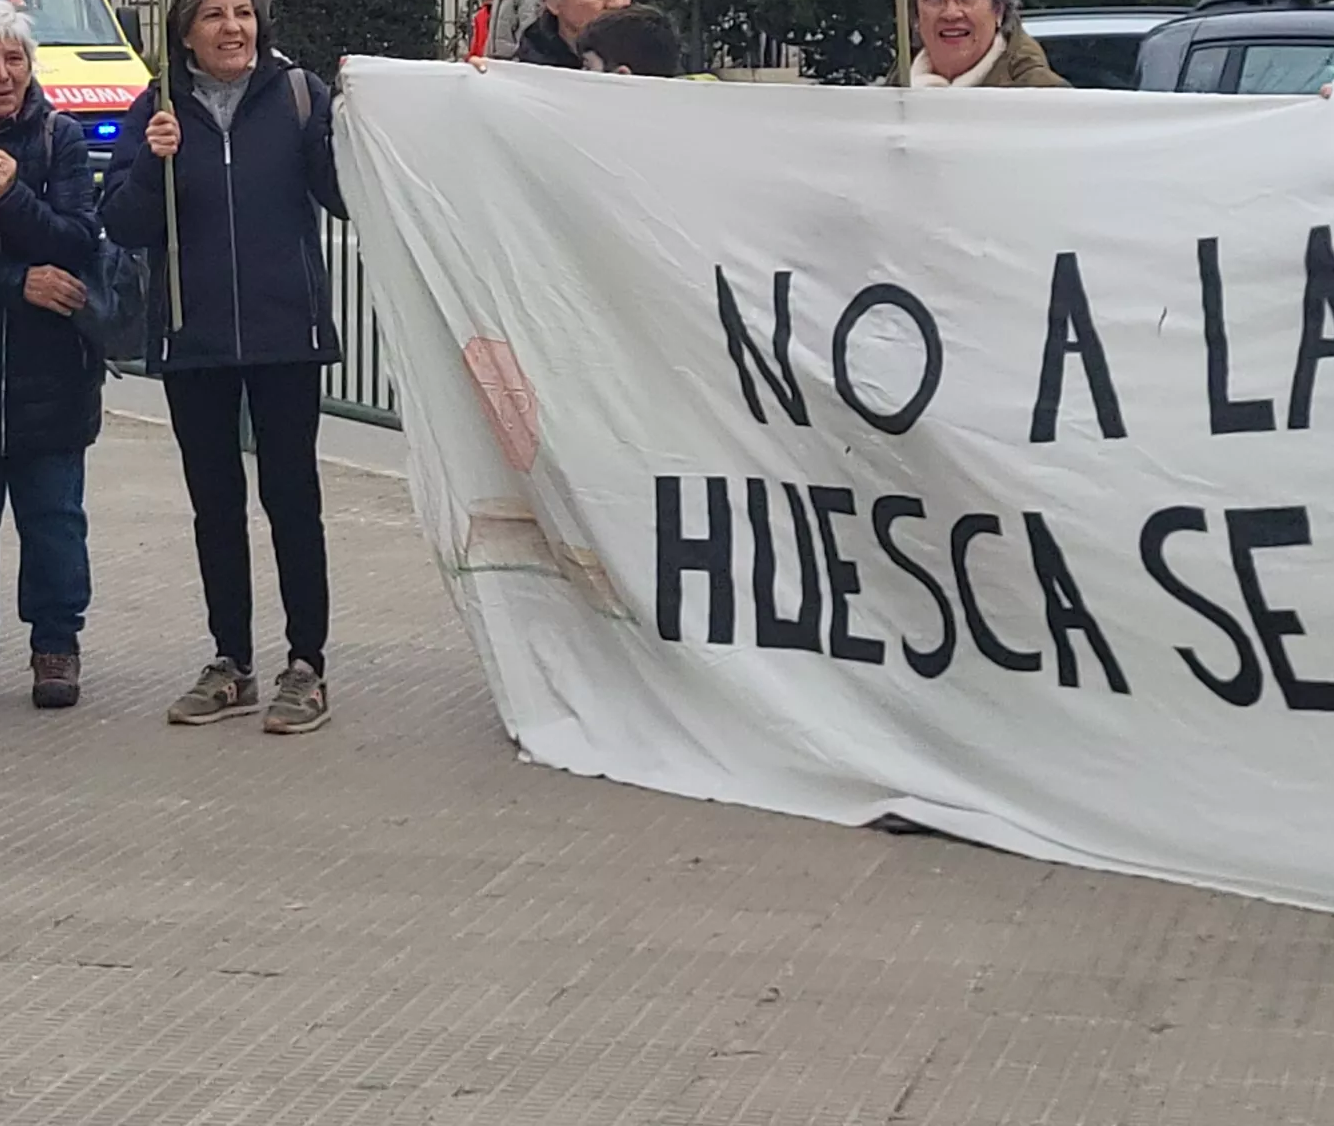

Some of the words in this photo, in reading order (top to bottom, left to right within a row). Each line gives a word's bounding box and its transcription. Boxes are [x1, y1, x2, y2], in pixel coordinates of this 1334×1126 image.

[713, 263, 943, 435] NO
[1029, 251, 1128, 443] A
[654, 475, 1132, 695] HUESCA
